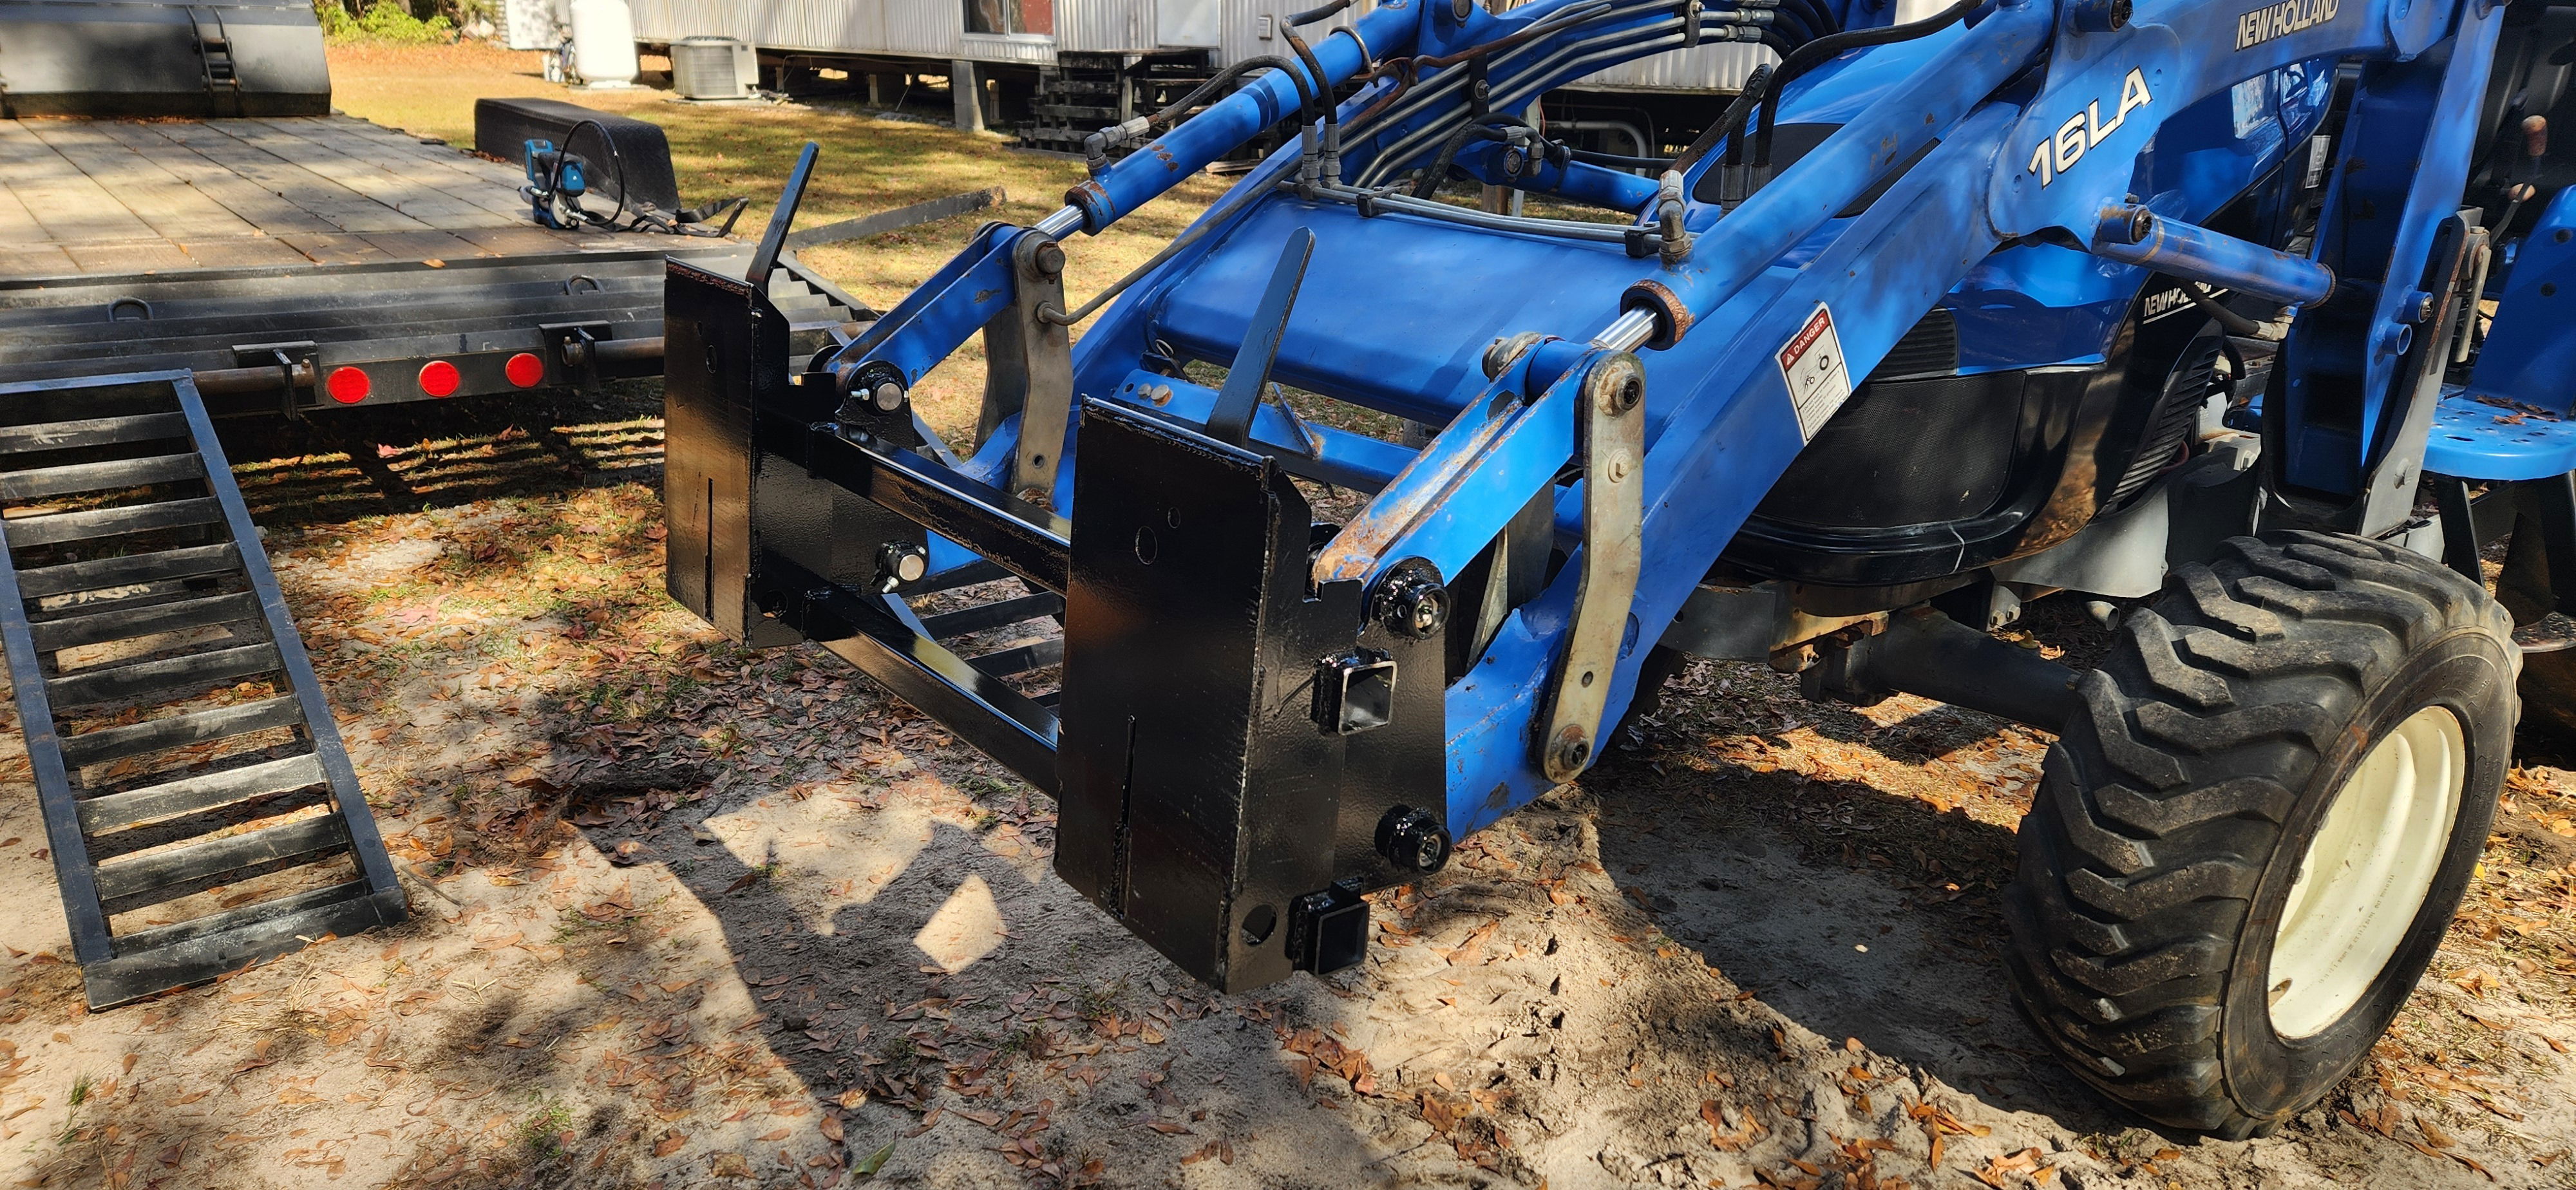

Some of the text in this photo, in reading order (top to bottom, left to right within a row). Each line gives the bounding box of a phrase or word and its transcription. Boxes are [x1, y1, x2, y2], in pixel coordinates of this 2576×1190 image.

[2235, 0, 2340, 51] NEW HOLLAND
[2027, 65, 2154, 189] 16LA
[2144, 281, 2211, 316] NEW HOLND
[1793, 317, 1826, 355] DANGER
